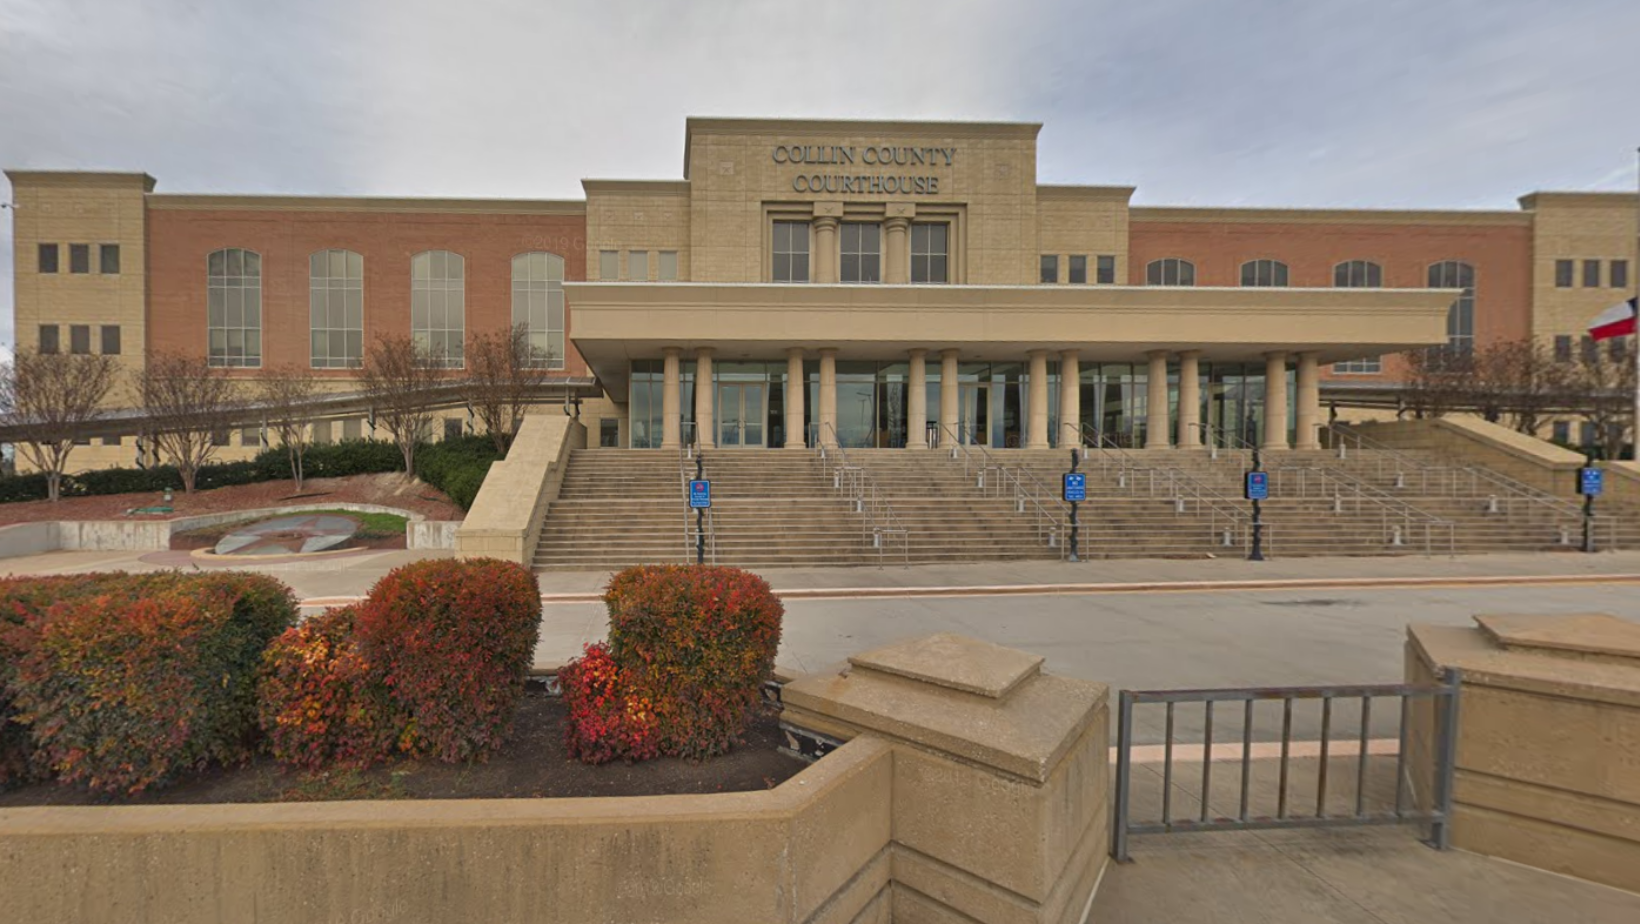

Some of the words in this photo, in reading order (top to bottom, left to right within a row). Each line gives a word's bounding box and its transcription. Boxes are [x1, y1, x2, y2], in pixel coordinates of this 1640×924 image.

[772, 146, 856, 165] COLLIN
[862, 147, 957, 166] COUNTY
[793, 175, 940, 194] COURTHOUSE
